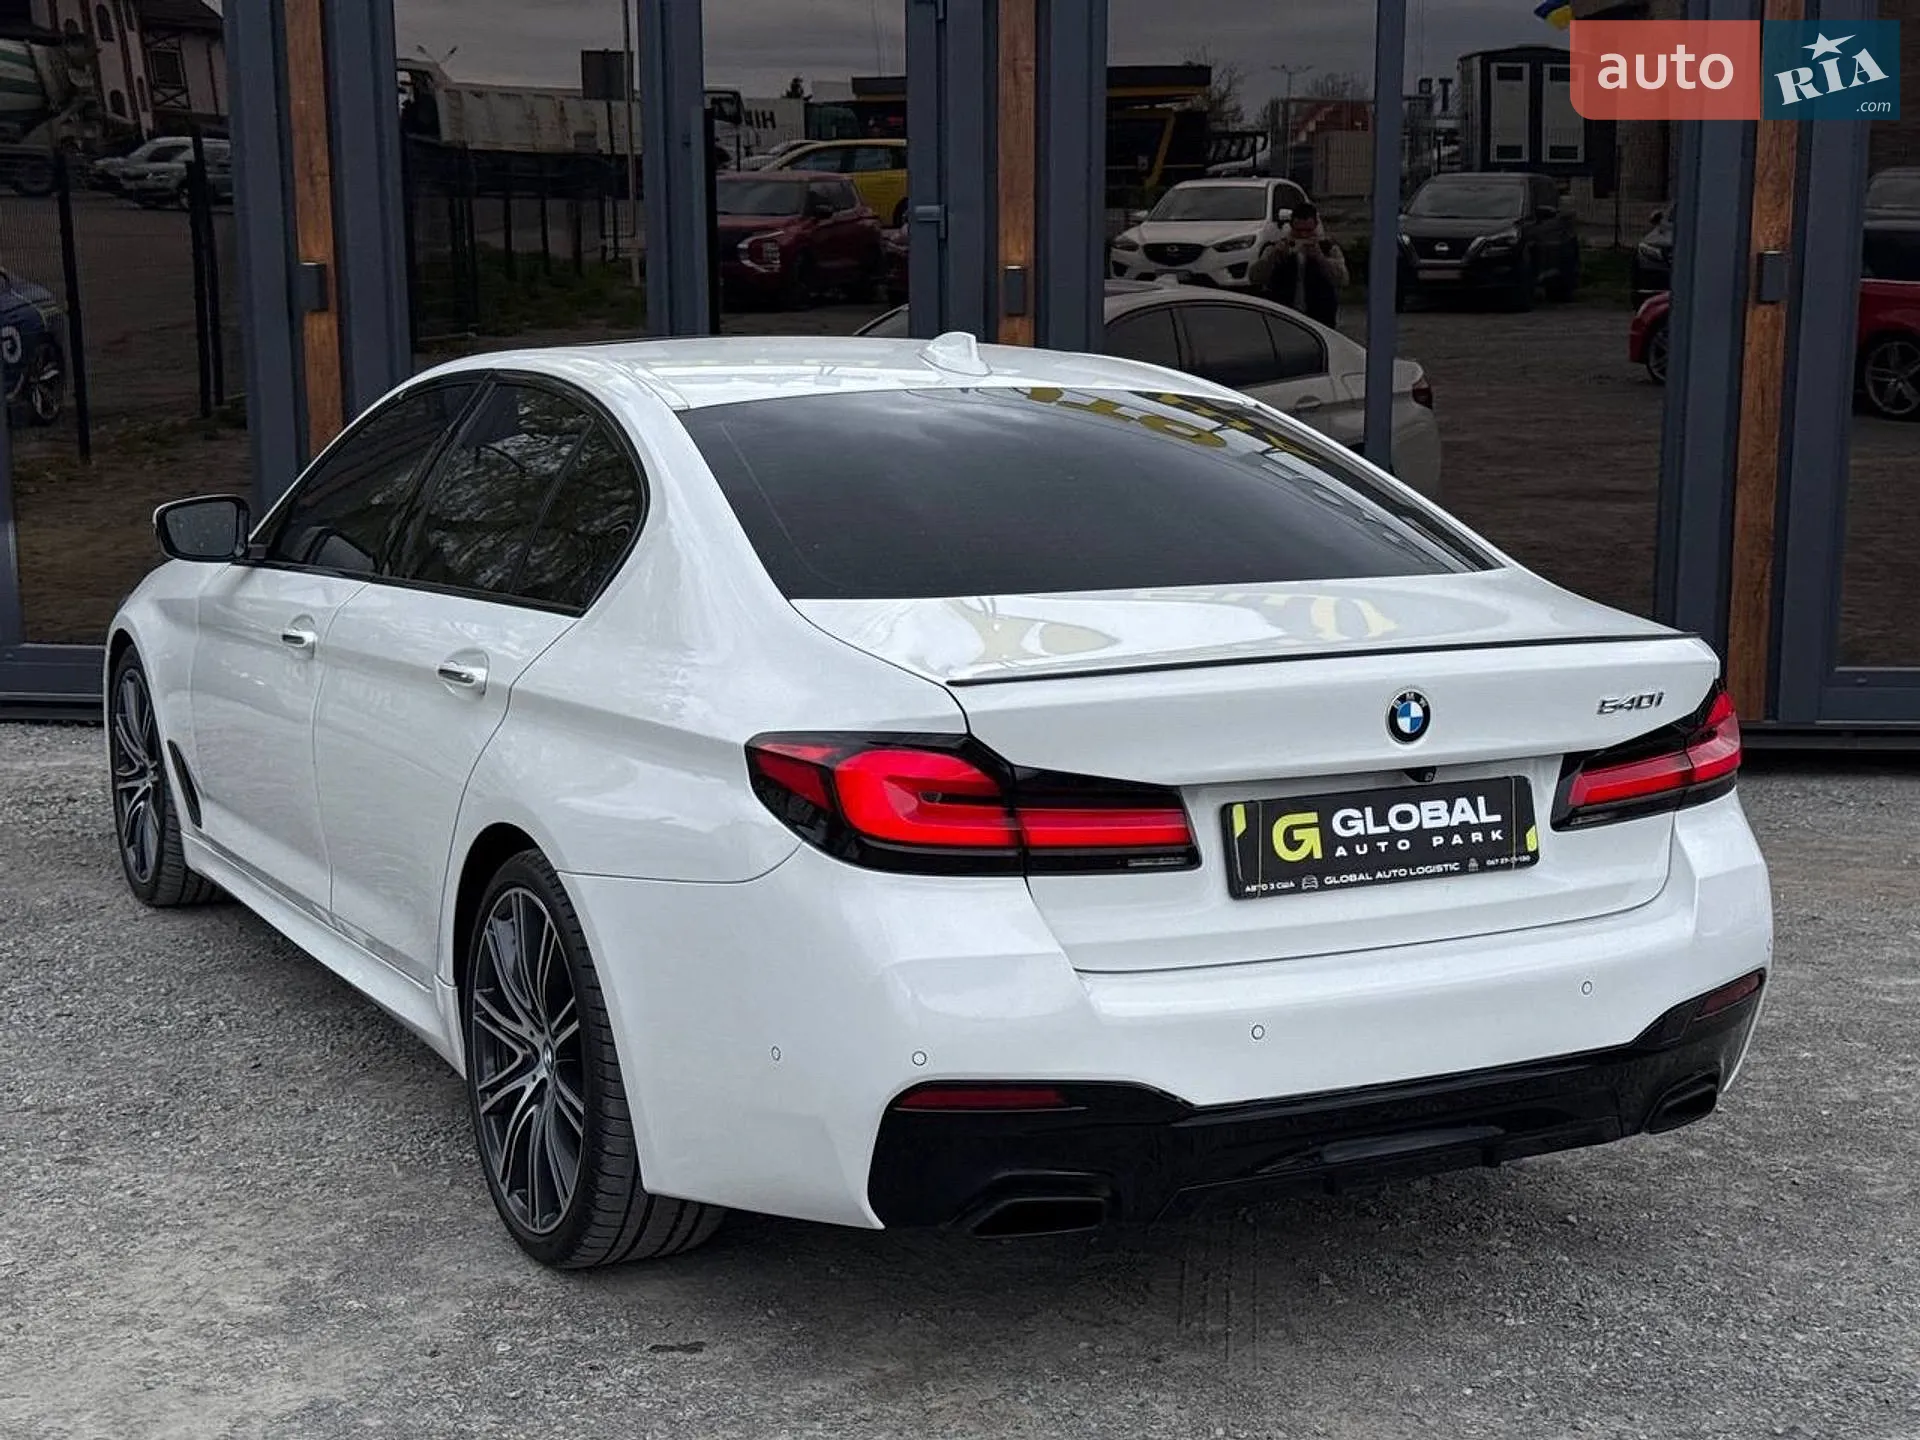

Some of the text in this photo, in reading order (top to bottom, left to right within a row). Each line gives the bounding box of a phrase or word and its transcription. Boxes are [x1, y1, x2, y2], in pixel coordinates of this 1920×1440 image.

[1596, 691, 1665, 715] 540i
[1331, 795, 1502, 838] GLOBAL
[1334, 829, 1504, 858] AUTO PARK
[1323, 862, 1461, 885] GLOBAL AUTO LOGISTIC
